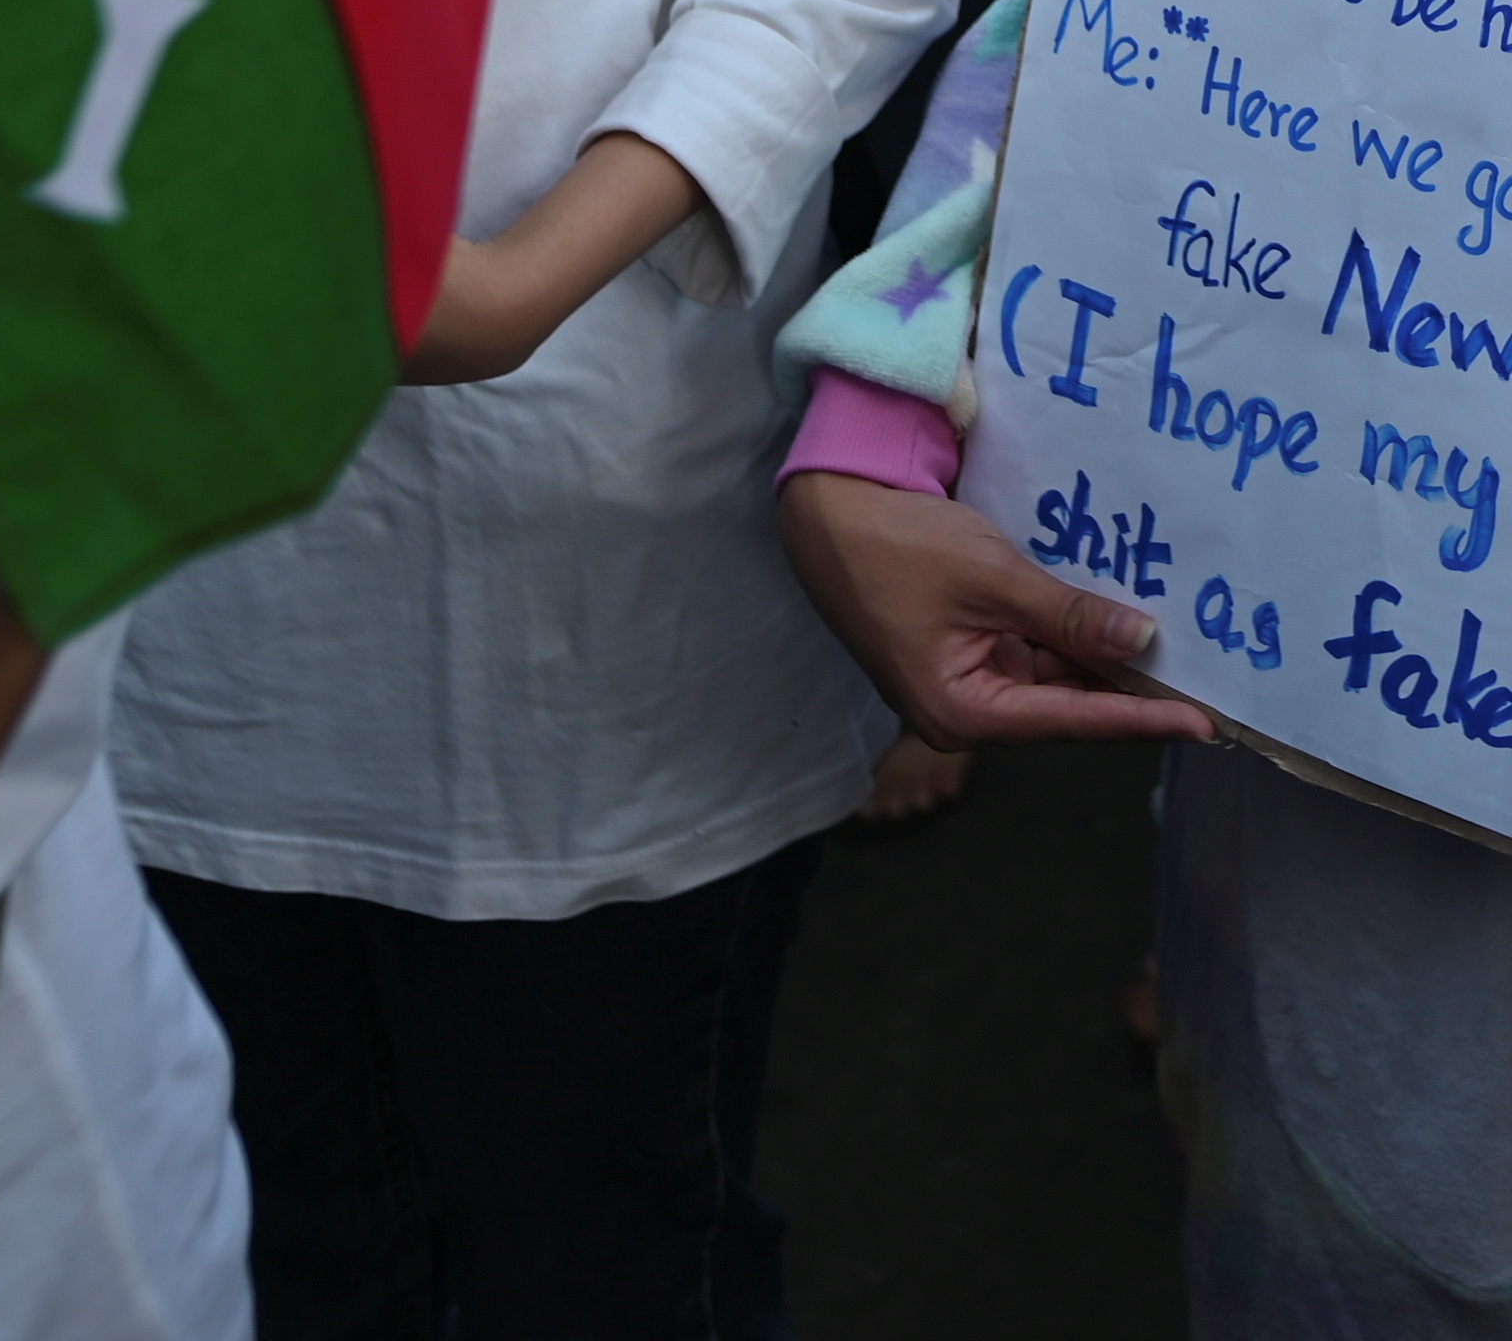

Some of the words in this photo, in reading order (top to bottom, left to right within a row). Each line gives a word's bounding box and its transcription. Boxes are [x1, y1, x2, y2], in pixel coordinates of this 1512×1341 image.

[1351, 119, 1444, 193] we
[1158, 179, 1291, 300] fake
[1148, 312, 1319, 492] hope
[1359, 419, 1500, 572] my
[1028, 469, 1172, 599] shit
[1194, 573, 1282, 671] as
